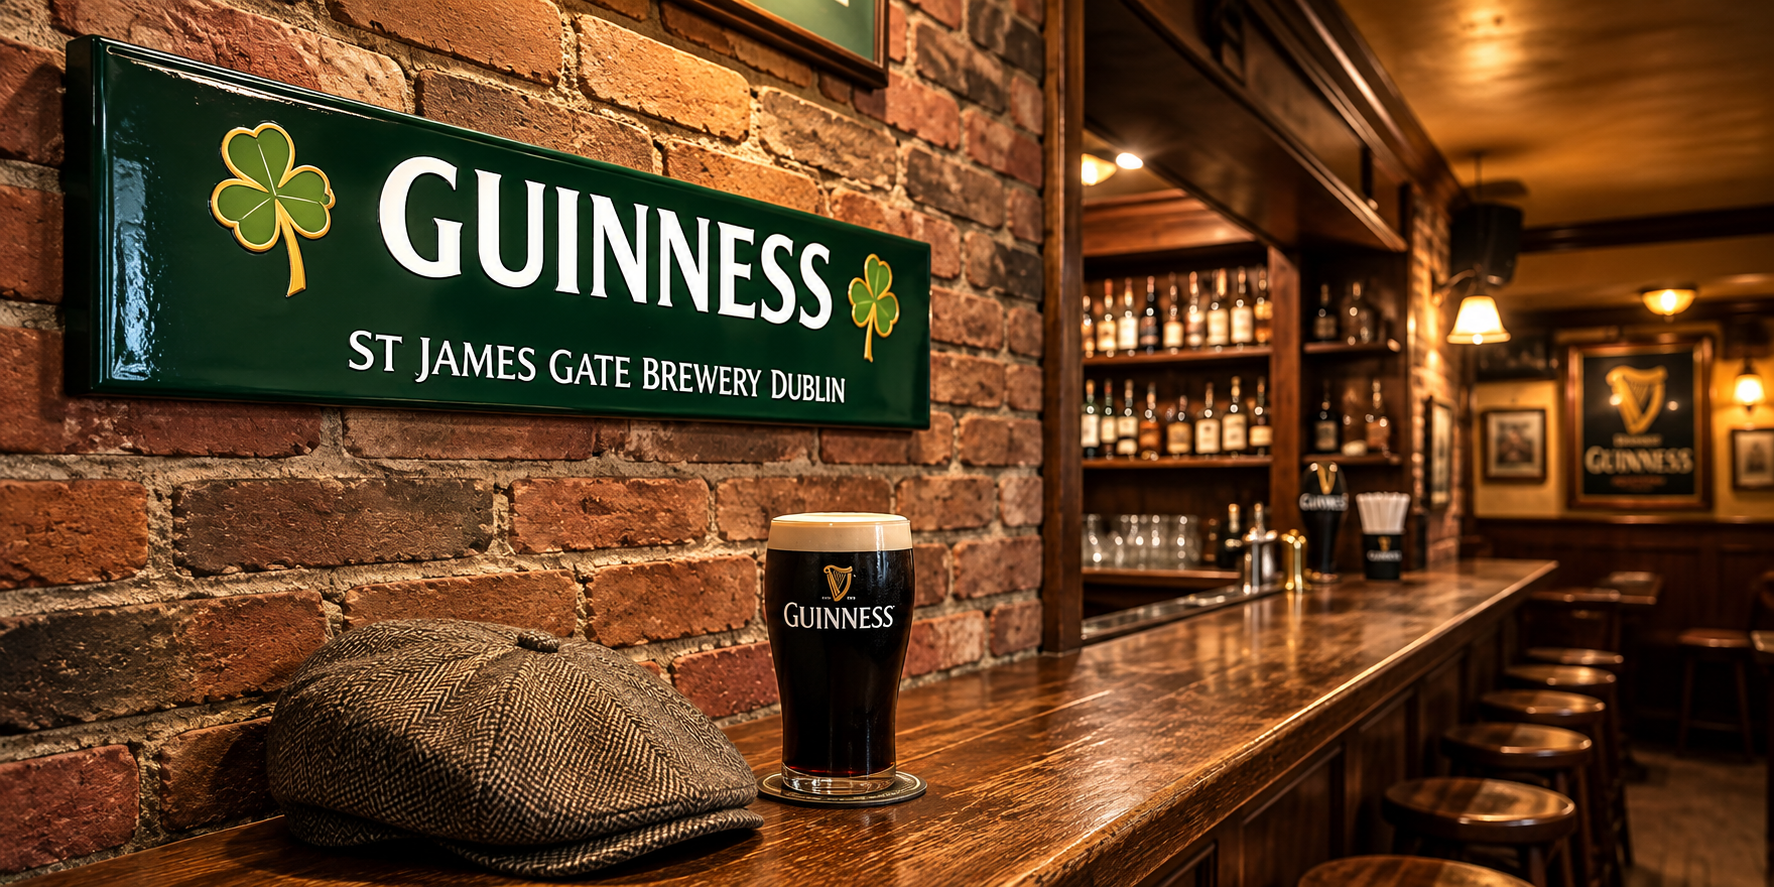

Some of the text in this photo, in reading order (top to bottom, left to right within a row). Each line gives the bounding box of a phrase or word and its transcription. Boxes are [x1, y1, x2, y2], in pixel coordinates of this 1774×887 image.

[378, 156, 833, 330] GUINNESS
[348, 330, 846, 404] ST JAMES GATE BREWERY DUBLIN
[783, 602, 895, 629] GUINNESS
